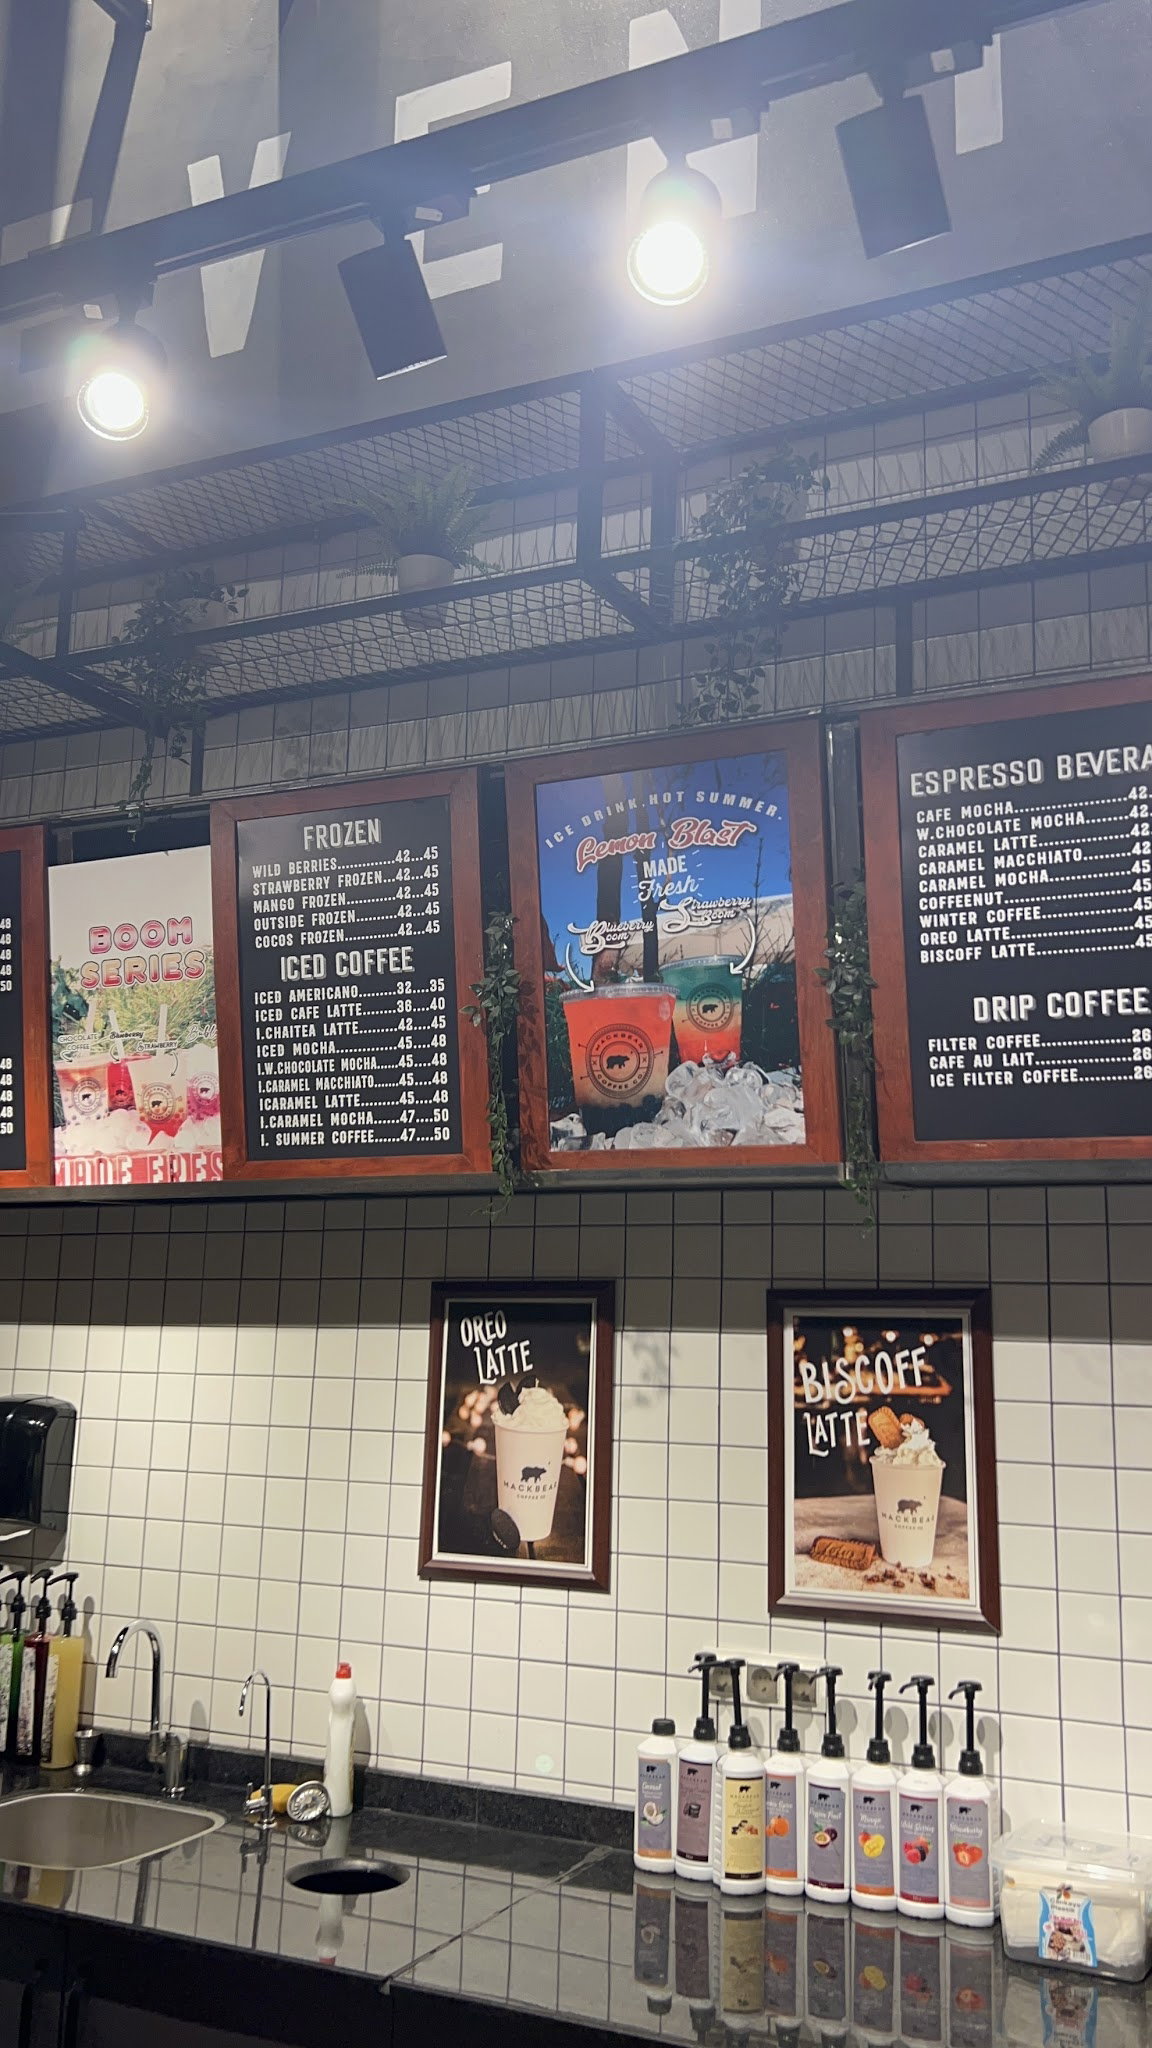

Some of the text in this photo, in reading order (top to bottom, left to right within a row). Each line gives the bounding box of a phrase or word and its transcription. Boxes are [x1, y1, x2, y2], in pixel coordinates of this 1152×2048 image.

[910, 758, 1044, 797] ESPRESSO
[916, 786, 1147, 823] CAFE MOCHA 42
[304, 818, 382, 850] FROZEN
[545, 824, 574, 848] ICE
[649, 792, 685, 805] HOT
[916, 804, 1148, 841] W.CHOCOLATE MOCHA 42
[576, 817, 756, 872] Lemon Blast
[918, 823, 1150, 858] CARAMEL LATTE 42
[252, 846, 438, 878] WILD BERRIES 42 45
[643, 855, 687, 878] MADE
[918, 841, 1151, 876] CARAMEL MACCHIATO 42
[253, 865, 438, 896] STRAWBERRY FROZEN 42 45
[638, 875, 700, 901] Fresh
[919, 860, 1151, 893] CARAMEL MOCHA 45
[254, 883, 439, 913] MANGO FROZEN 42 45
[919, 878, 1152, 910] COFFEENUT 45
[254, 902, 440, 931] OUTSIDE FROZEN 42 45
[660, 896, 752, 933] Strawberry
[920, 896, 1152, 928] WINTER COFFEE 45
[89, 916, 193, 954] BOOM
[256, 920, 440, 948] COCOS FROZEN 42 45
[567, 920, 654, 955] Blueberry
[920, 916, 1152, 946] OREO LATTE 45
[280, 946, 415, 981] ICED COFFEE
[920, 947, 981, 964] BISCOFF
[992, 943, 1035, 959] LATTE
[0, 965, 12, 976] 48
[80, 950, 205, 988] SERIES
[255, 978, 444, 1004] ICED AMERICANO 32 35
[973, 987, 1152, 1023] DRIP COFFEE
[256, 997, 446, 1022] ICED CAFE LATTE 36 40
[110, 1031, 144, 1040] Blueberry
[256, 1016, 446, 1040] I.CHAITEA LATTE 42 45
[928, 1028, 1152, 1052] FILTER COFFEE 26
[138, 1041, 178, 1051] STRAWBERRY
[257, 1034, 446, 1058] ICED MOCHA 45 48
[930, 1046, 1152, 1070] CAFE AU LAIT 26
[258, 1052, 446, 1076] I.W.CHOCOLATE MOCHA 45 48
[930, 1065, 1152, 1088] ICE FILTER COFFEE 26
[0, 1090, 12, 1101] 48
[258, 1071, 448, 1093] I.CARAMEL MACCHIATO 45 48
[0, 1106, 13, 1118] 48
[260, 1090, 448, 1110] ICARAMEL LATTE 45 48
[260, 1108, 449, 1128] I.CARAMEL MOCHA 47 50
[276, 1132, 324, 1146] SUMMER
[332, 1130, 374, 1144] COFFEE
[400, 1128, 416, 1142] 47
[434, 1127, 450, 1140] 50
[460, 1310, 506, 1347] OREO
[474, 1340, 533, 1384] LATTE
[799, 1346, 926, 1404] BISCOFF
[804, 1410, 870, 1457] LATTE
